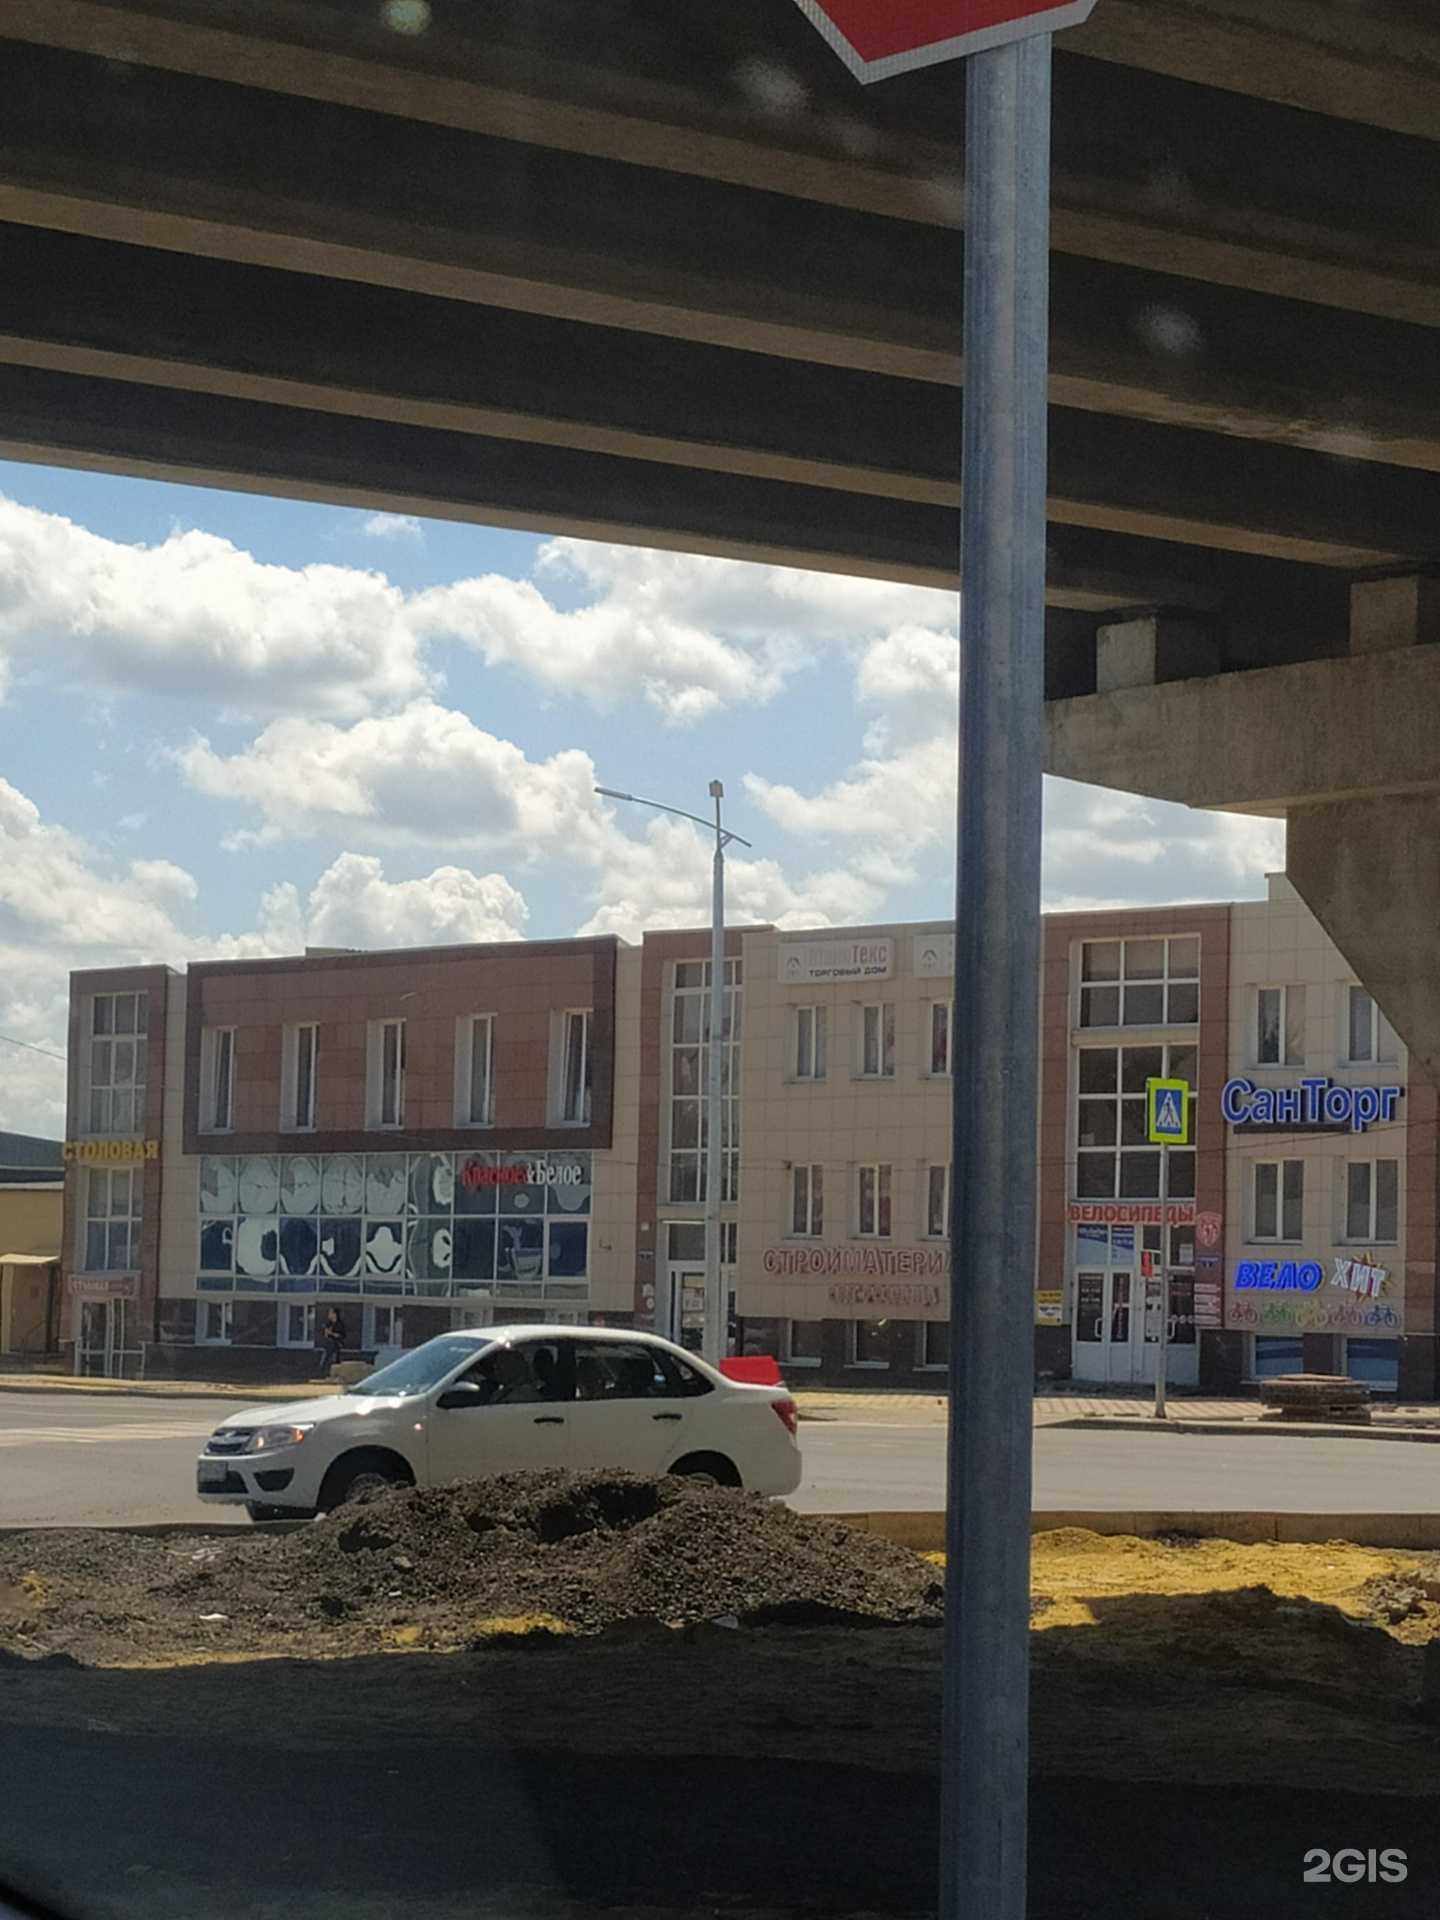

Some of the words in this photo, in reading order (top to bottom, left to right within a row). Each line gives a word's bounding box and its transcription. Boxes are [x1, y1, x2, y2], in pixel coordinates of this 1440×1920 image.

[808, 968, 861, 977] ТОРГОВЫЙ
[864, 966, 887, 975] ДОМ
[1222, 1077, 1400, 1133] СанТорг
[63, 1141, 158, 1160] СТОЛОВАЯ
[1071, 1205, 1194, 1224] ВЕЛОСИПЕДЫ
[763, 1247, 949, 1274] СТРОЙМАТЕРИ
[1234, 1260, 1323, 1293] ВЕЛО
[1331, 1257, 1386, 1297] ХИТ
